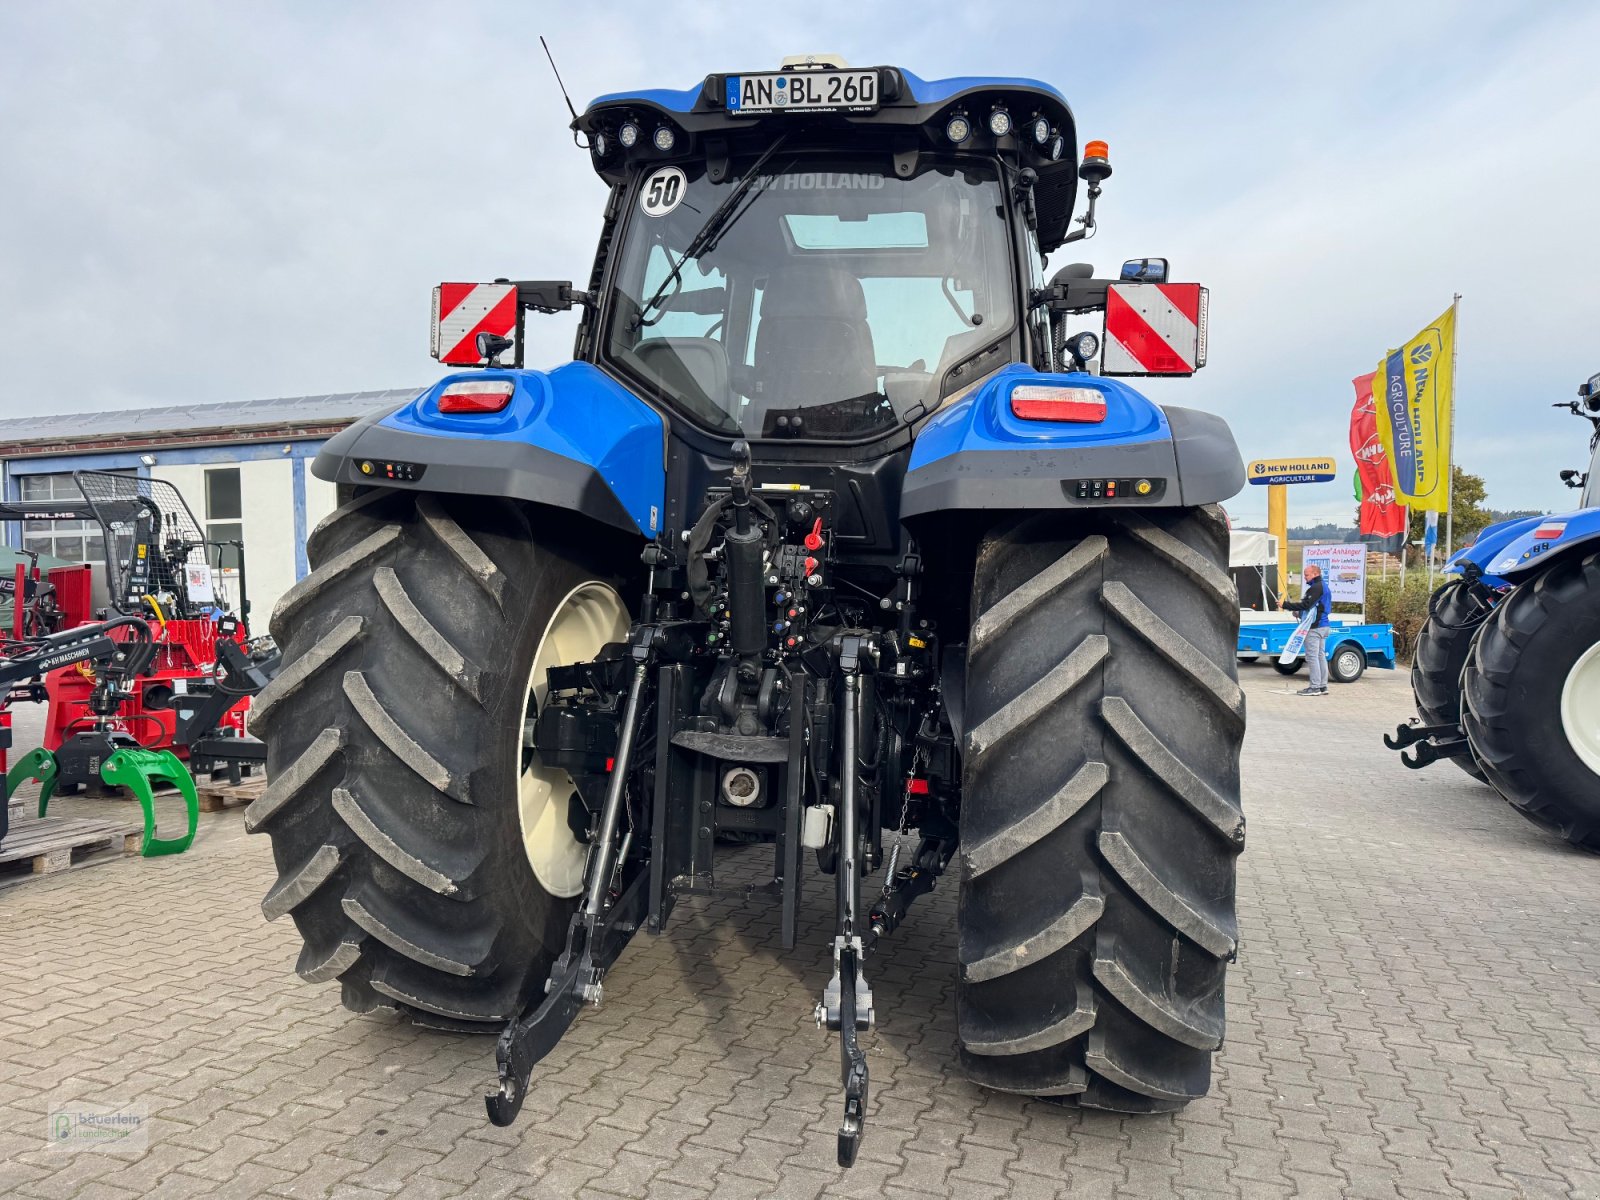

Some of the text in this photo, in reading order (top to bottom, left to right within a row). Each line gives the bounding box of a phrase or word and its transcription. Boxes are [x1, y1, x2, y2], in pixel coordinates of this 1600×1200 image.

[742, 75, 874, 105] AN BL 260
[783, 172, 885, 190] HOLLAND
[646, 175, 681, 208] 50
[1391, 375, 1411, 457] AGRICULTURE
[1289, 463, 1330, 471] HOLLAND
[1269, 475, 1316, 483] AGRICULTURE
[59, 648, 90, 662] MASCHINEN
